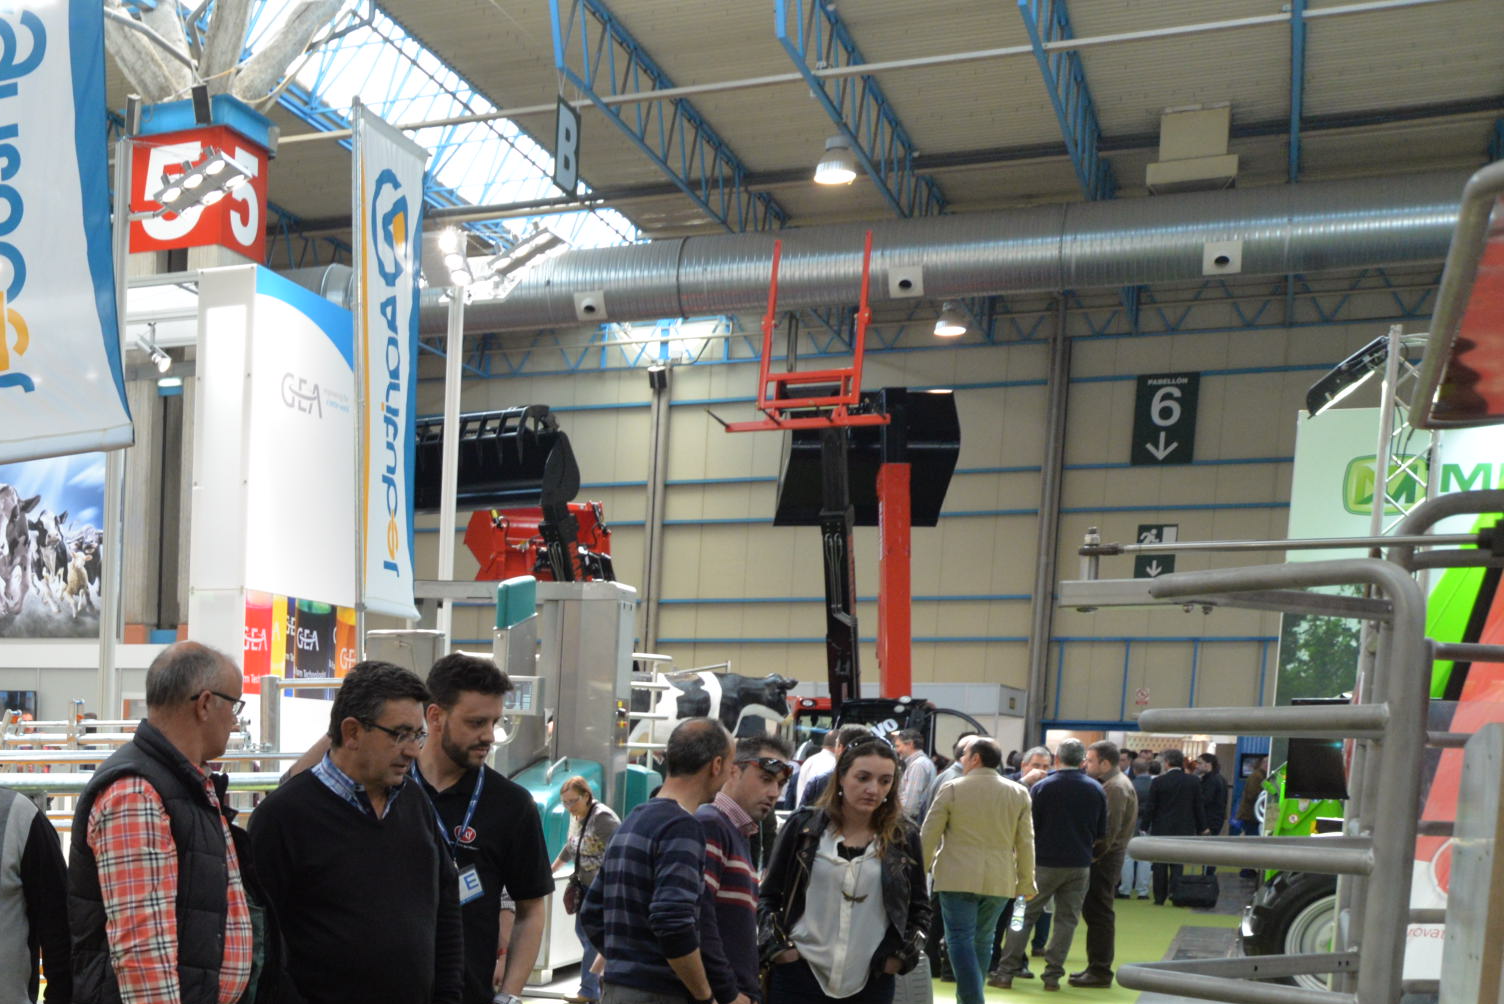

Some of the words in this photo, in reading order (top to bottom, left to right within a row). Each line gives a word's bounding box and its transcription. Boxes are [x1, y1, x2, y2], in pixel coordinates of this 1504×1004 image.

[556, 102, 578, 192] B
[141, 141, 202, 241] 5
[229, 146, 259, 247] 5
[281, 372, 322, 419] GEA
[1150, 386, 1182, 427] 6
[1439, 463, 1504, 493] M
[297, 628, 320, 651] GEA
[463, 872, 480, 891] E
